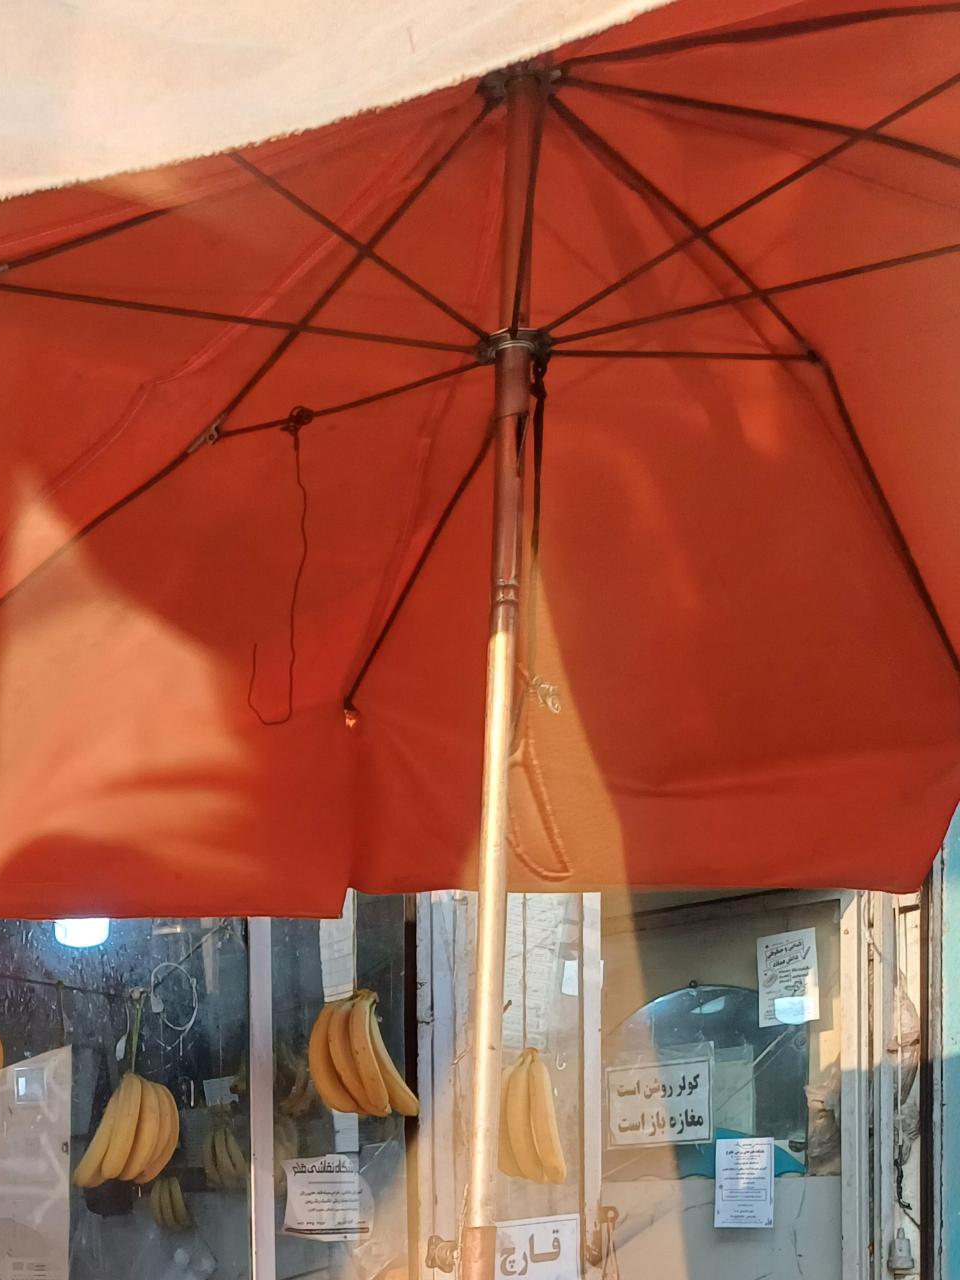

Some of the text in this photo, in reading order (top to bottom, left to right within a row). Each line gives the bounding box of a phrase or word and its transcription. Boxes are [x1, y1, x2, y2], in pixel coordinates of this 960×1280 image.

[617, 1073, 700, 1100] کولر روشن است
[618, 1108, 704, 1136] مغازه باز است
[500, 1228, 562, 1277] قارچ
